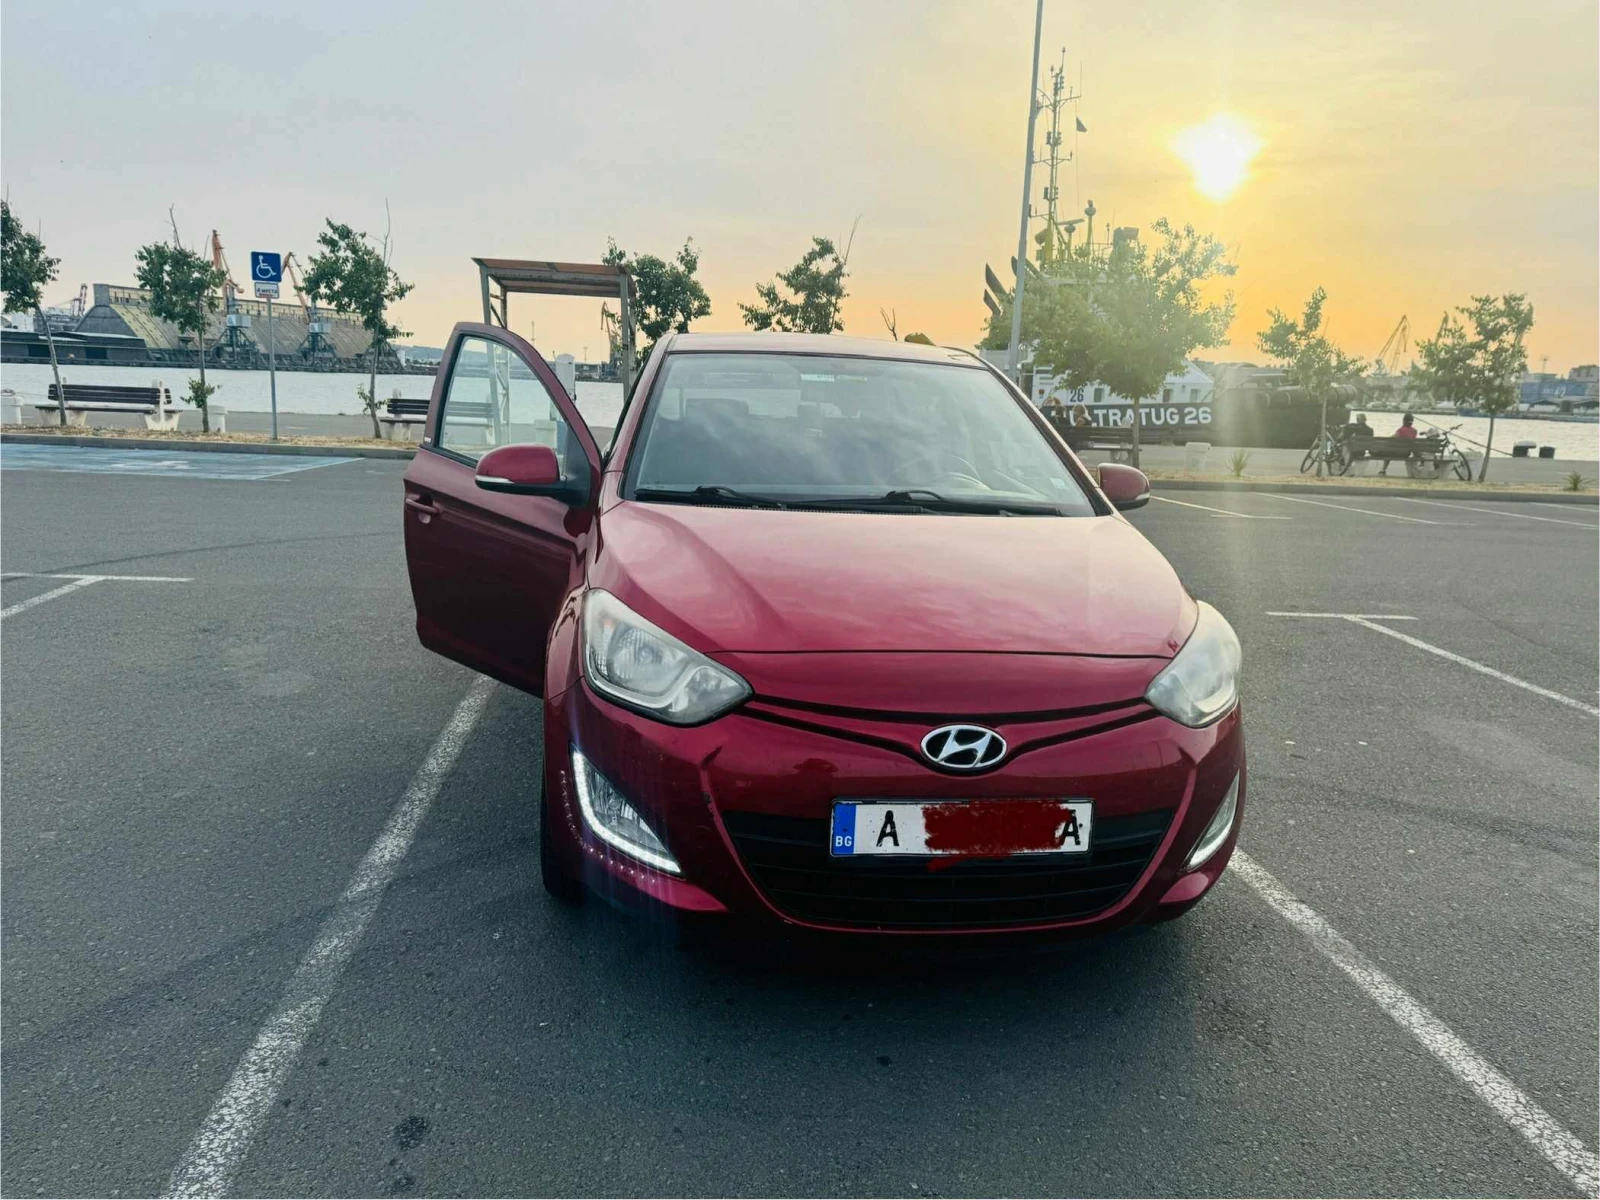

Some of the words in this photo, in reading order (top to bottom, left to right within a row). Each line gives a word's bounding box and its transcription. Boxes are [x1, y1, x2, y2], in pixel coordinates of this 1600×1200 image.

[1070, 387, 1084, 402] 26
[1183, 406, 1212, 425] 26
[876, 809, 900, 847] A
[835, 835, 853, 848] BG
